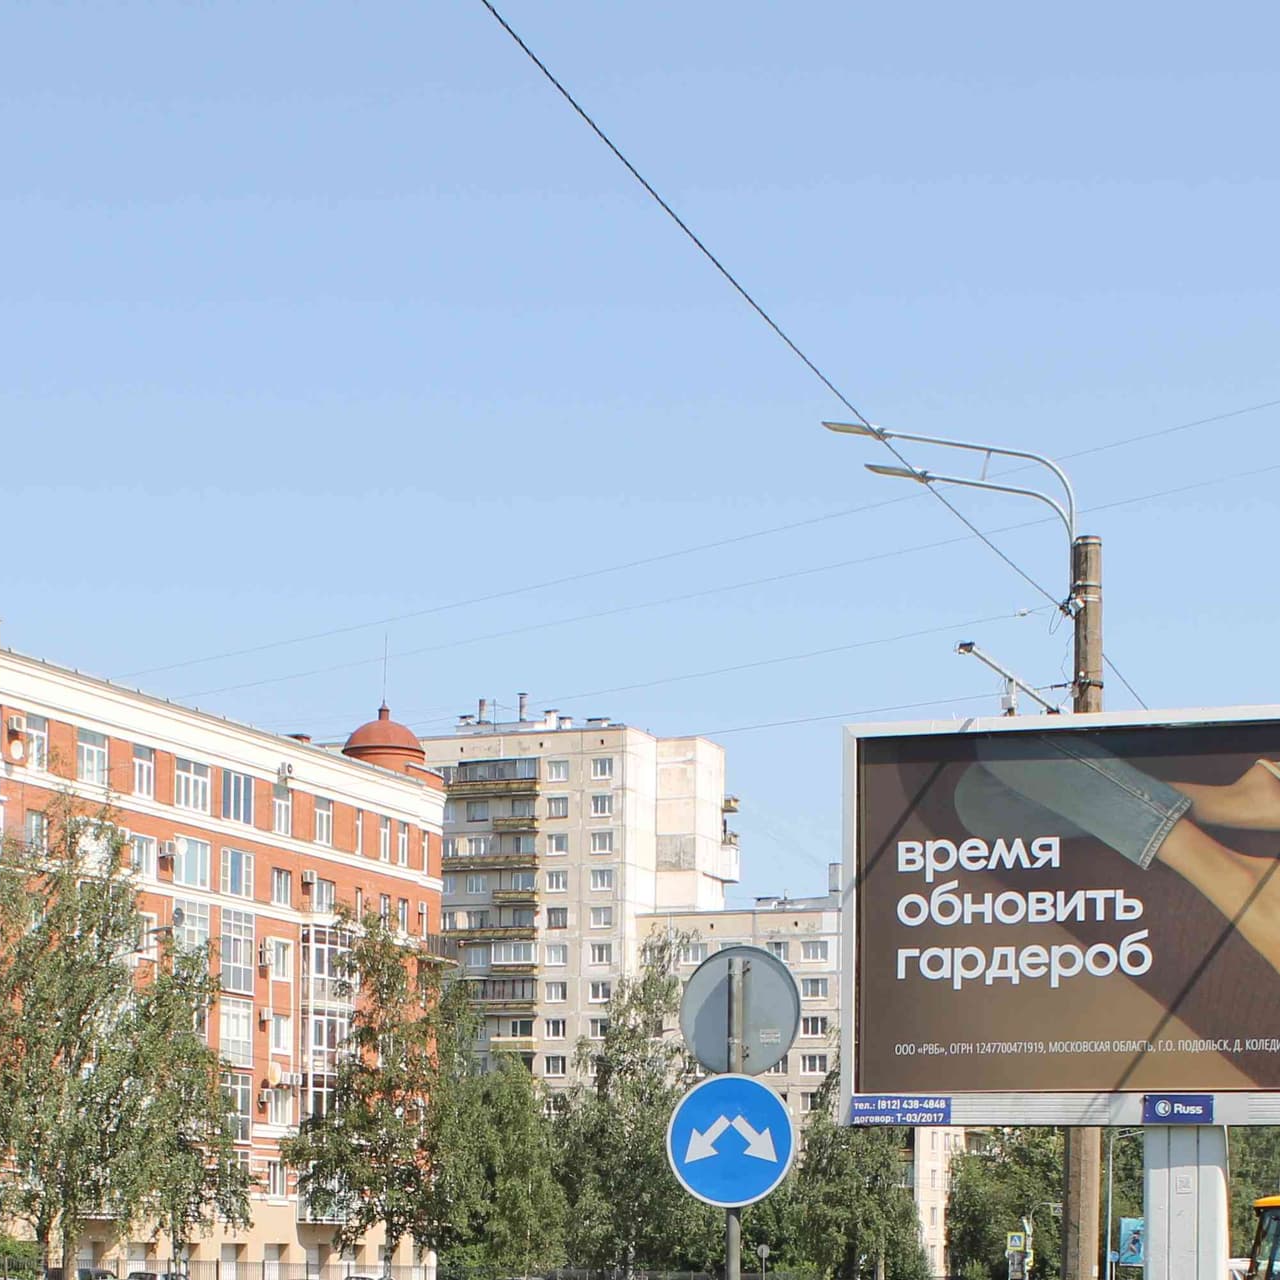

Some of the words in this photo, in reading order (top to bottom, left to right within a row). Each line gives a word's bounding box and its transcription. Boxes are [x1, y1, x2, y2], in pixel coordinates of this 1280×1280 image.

[897, 836, 1061, 883] время
[896, 879, 1144, 927] обновить
[897, 928, 1153, 990] гардероб
[894, 1043, 916, 1055] ООО
[917, 1043, 948, 1056] «РВБ»,
[949, 1042, 973, 1055] ОГРН
[975, 1041, 1046, 1054] 1247700471919,
[1048, 1040, 1111, 1053] МОСКОВСКАЯ
[1112, 1040, 1156, 1053] ОБЛАСТЬ,
[1158, 1040, 1176, 1052] Г.О.
[1177, 1039, 1232, 1053] ПОДОЛЬСК,
[1232, 1039, 1243, 1052] Д.
[853, 1101, 876, 1110] тел.:
[877, 1099, 900, 1110] (812)
[902, 1099, 946, 1109] 438-4848
[1173, 1102, 1204, 1115] Russ
[852, 1114, 895, 1124] договор:
[895, 1112, 945, 1123] Т-03/2017
